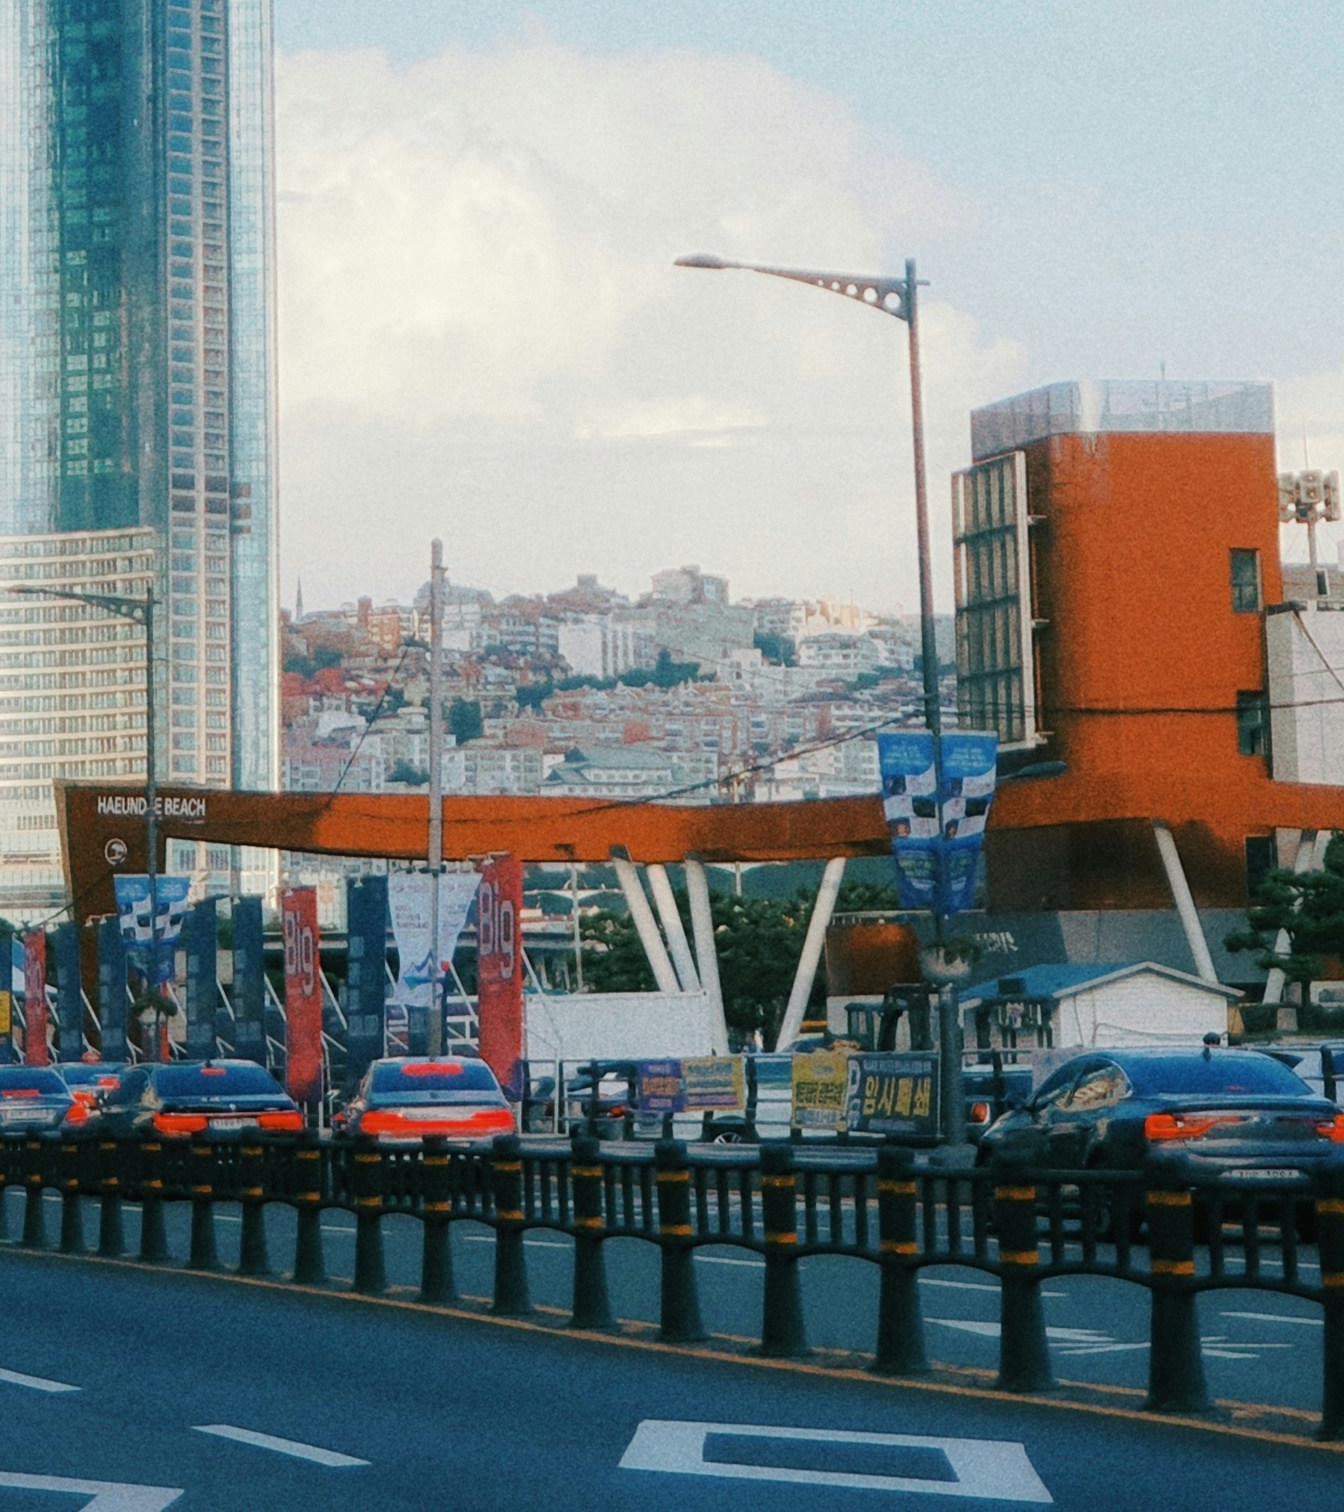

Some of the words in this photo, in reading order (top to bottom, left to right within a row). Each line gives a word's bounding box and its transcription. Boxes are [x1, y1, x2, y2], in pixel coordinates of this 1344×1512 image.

[97, 795, 163, 815] HAEUNDE
[164, 797, 206, 816] BEACH
[283, 909, 314, 997] Big
[479, 880, 515, 980] Big
